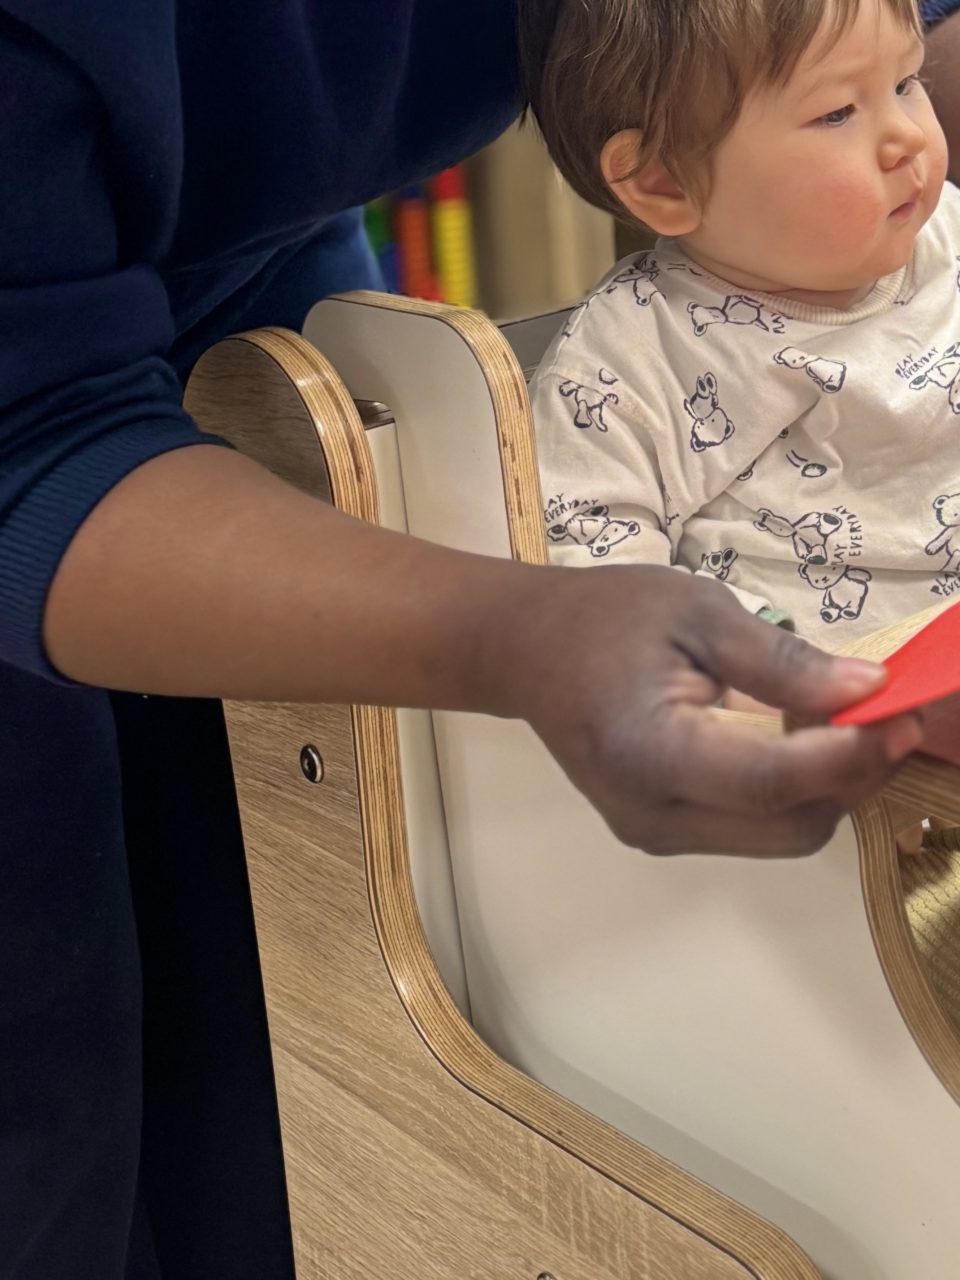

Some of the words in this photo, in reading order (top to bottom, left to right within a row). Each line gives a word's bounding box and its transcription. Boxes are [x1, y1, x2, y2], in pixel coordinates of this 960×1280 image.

[894, 353, 915, 378] PLAY
[902, 347, 940, 380] EVERYDAY
[544, 498, 600, 524] EVERYDAY
[547, 492, 565, 509] AY
[832, 505, 863, 557] EVERYDAY
[830, 544, 848, 566] LAY
[930, 572, 957, 596] PLA
